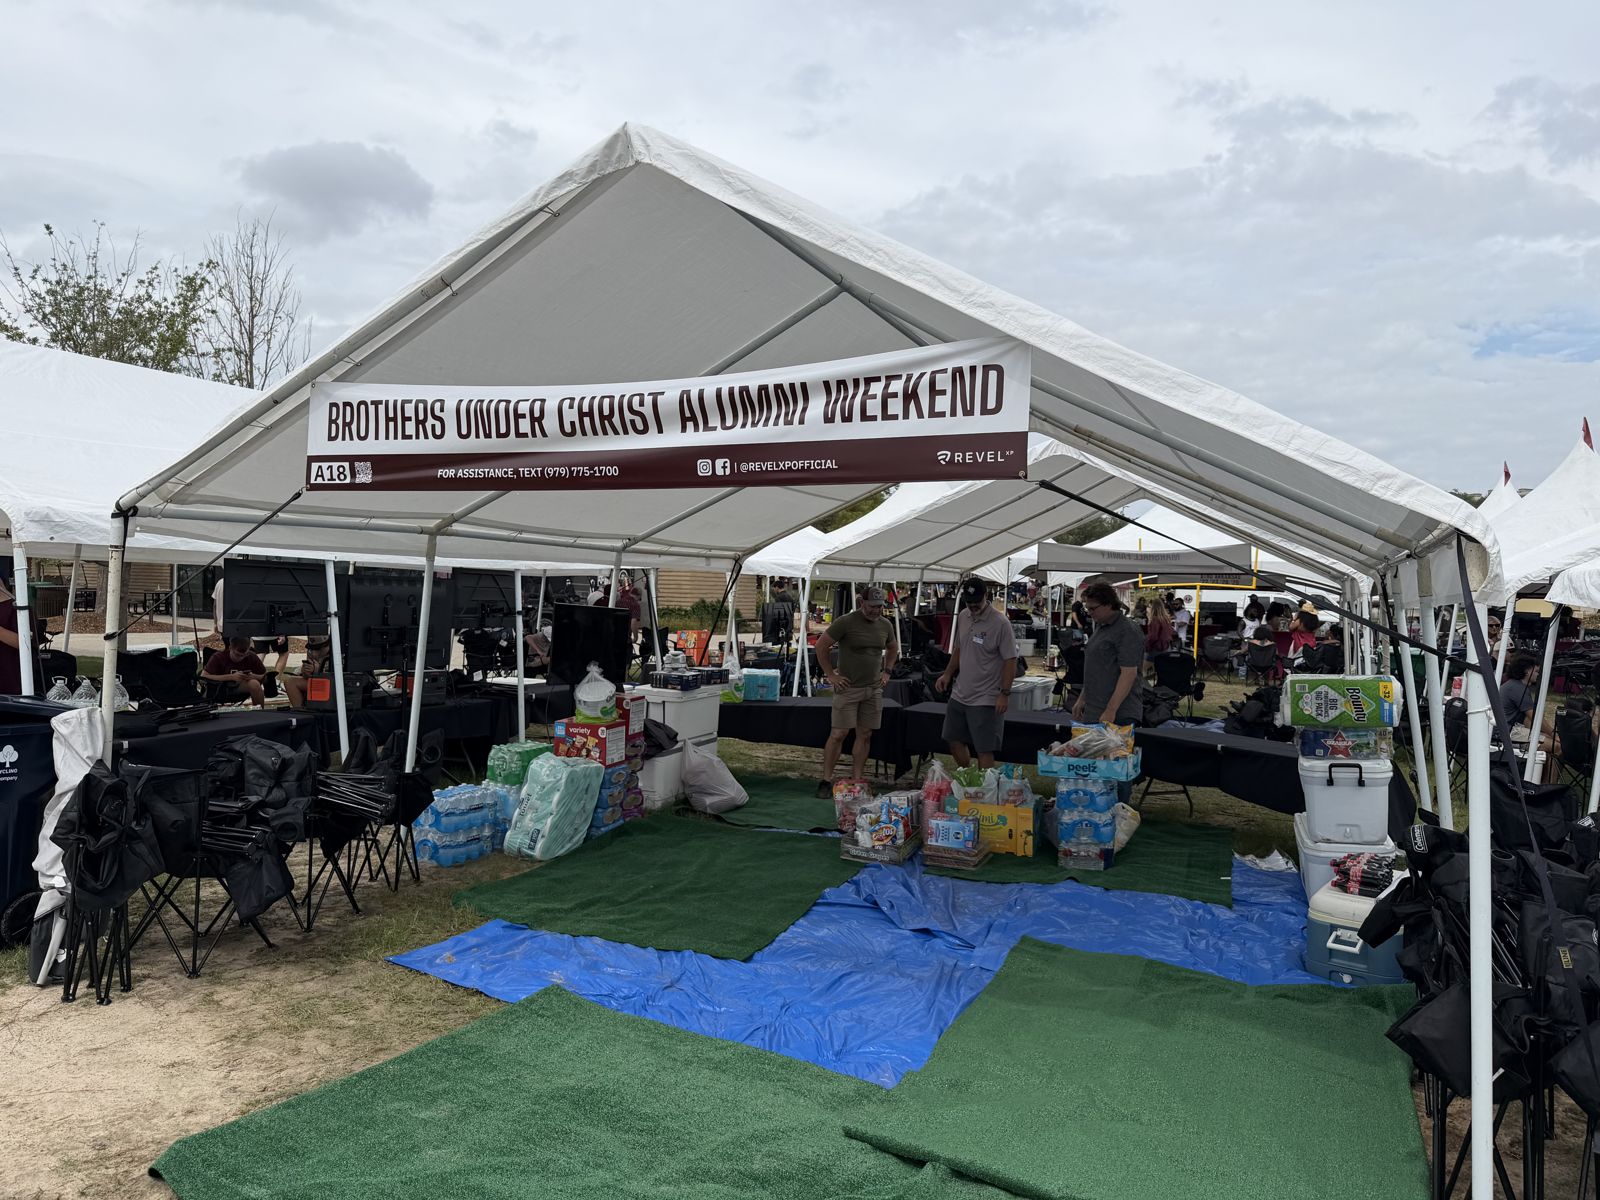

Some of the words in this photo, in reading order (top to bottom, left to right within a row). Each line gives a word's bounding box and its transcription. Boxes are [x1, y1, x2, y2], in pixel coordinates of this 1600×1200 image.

[327, 398, 447, 442] BROTHERS
[455, 398, 549, 440] UNDER
[557, 391, 666, 437] CHRIST
[678, 379, 811, 434] ALUMNI
[823, 363, 1005, 425] WEEKEND
[954, 450, 1004, 464] REVEL
[313, 462, 349, 483] A18
[437, 468, 455, 479] FOR
[456, 467, 517, 480] ASSISTANCE,
[518, 466, 543, 478] TEXT
[544, 465, 570, 479] (979)
[570, 465, 619, 477] 775-1700
[739, 458, 839, 473] @REVELXPOFFICIAL
[1315, 690, 1323, 701] BIG
[1328, 697, 1338, 711] BIG
[1345, 687, 1367, 723] Bounty
[569, 726, 591, 735] variety
[1068, 762, 1098, 774] peelz
